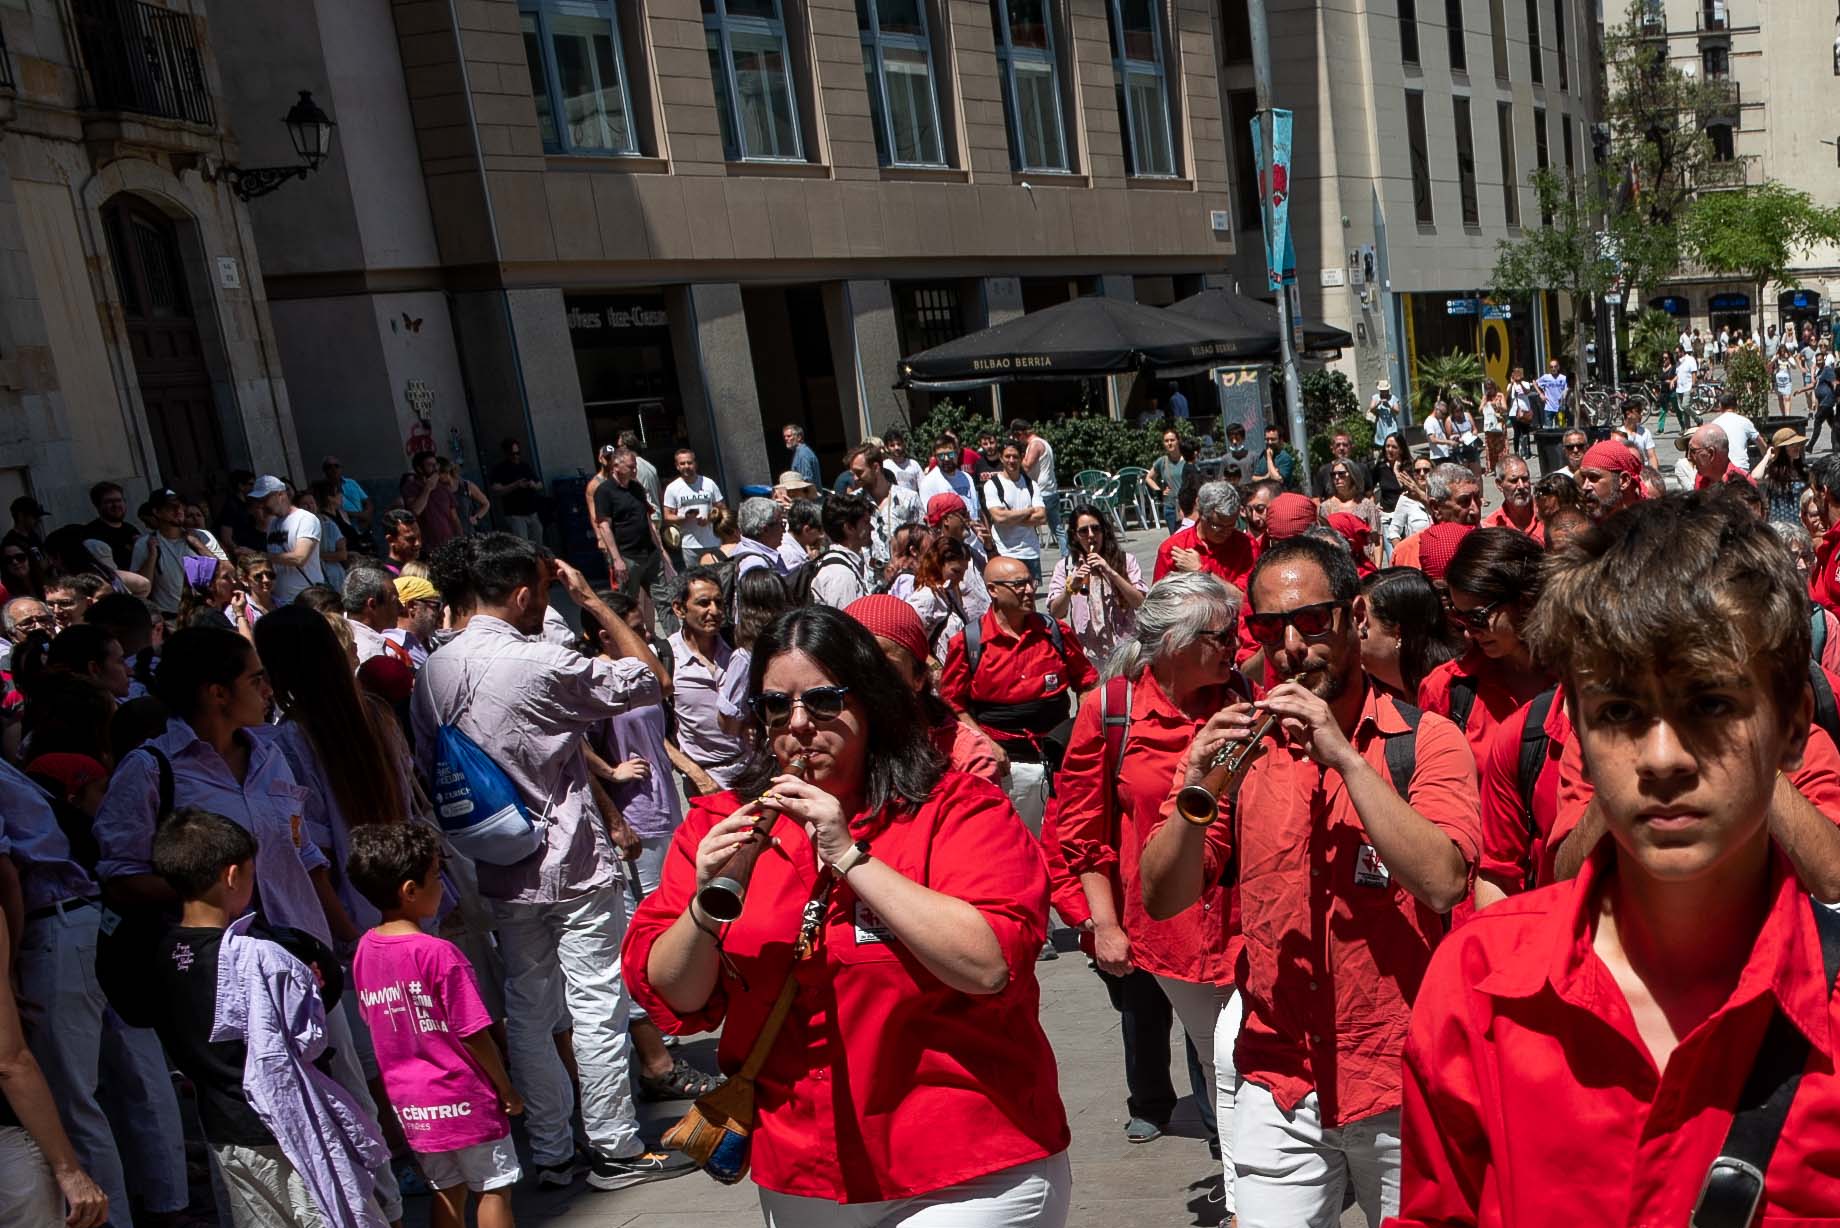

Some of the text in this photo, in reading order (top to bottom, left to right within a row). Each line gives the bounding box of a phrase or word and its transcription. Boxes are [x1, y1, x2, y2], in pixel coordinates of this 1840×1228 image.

[973, 356, 1052, 370] BILBAO BERRIA
[415, 1006, 430, 1019] LA
[419, 1019, 449, 1033] COLLA
